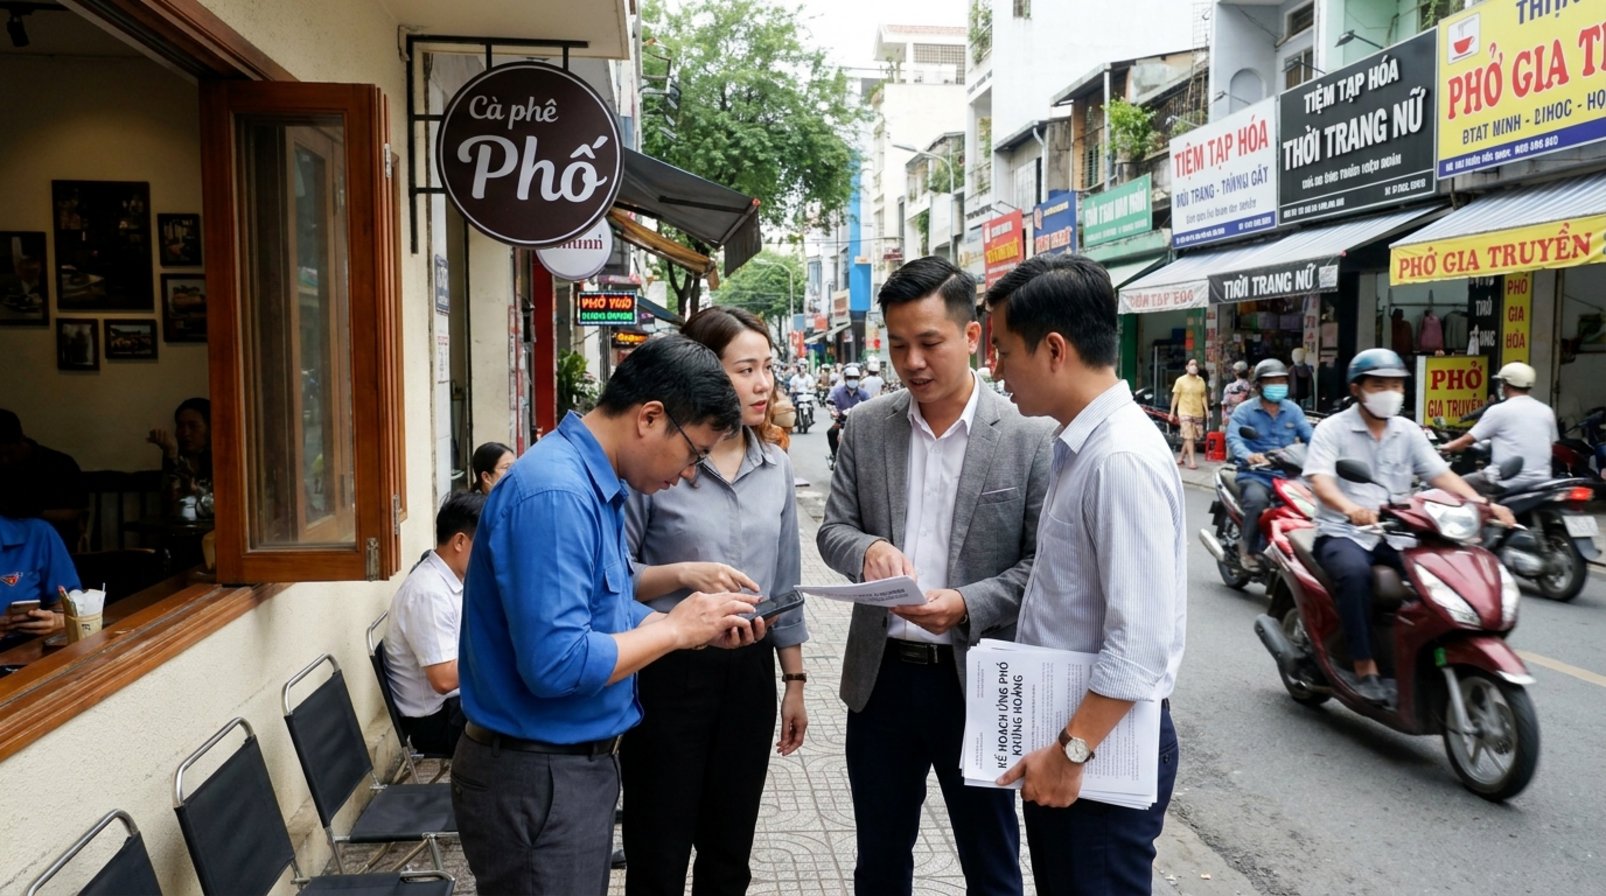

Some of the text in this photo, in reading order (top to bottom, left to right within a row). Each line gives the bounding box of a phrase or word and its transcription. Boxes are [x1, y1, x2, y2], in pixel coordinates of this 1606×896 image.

[1304, 54, 1399, 115] TIỆM TẠP HÓA
[1448, 42, 1503, 120] PHỞ
[1512, 39, 1569, 98] GIA
[469, 95, 558, 130] Cà phê
[1283, 86, 1426, 170] THỜI TRANG NỮ
[457, 135, 608, 202] Phố
[1174, 114, 1268, 180] TIỆM TẠP HÓA
[1252, 272, 1292, 296] TRANG
[1398, 247, 1437, 278] PHỞ
[1442, 250, 1480, 273] GIA
[1431, 361, 1482, 390] PHỞ
[996, 662, 1008, 684] PHÓ
